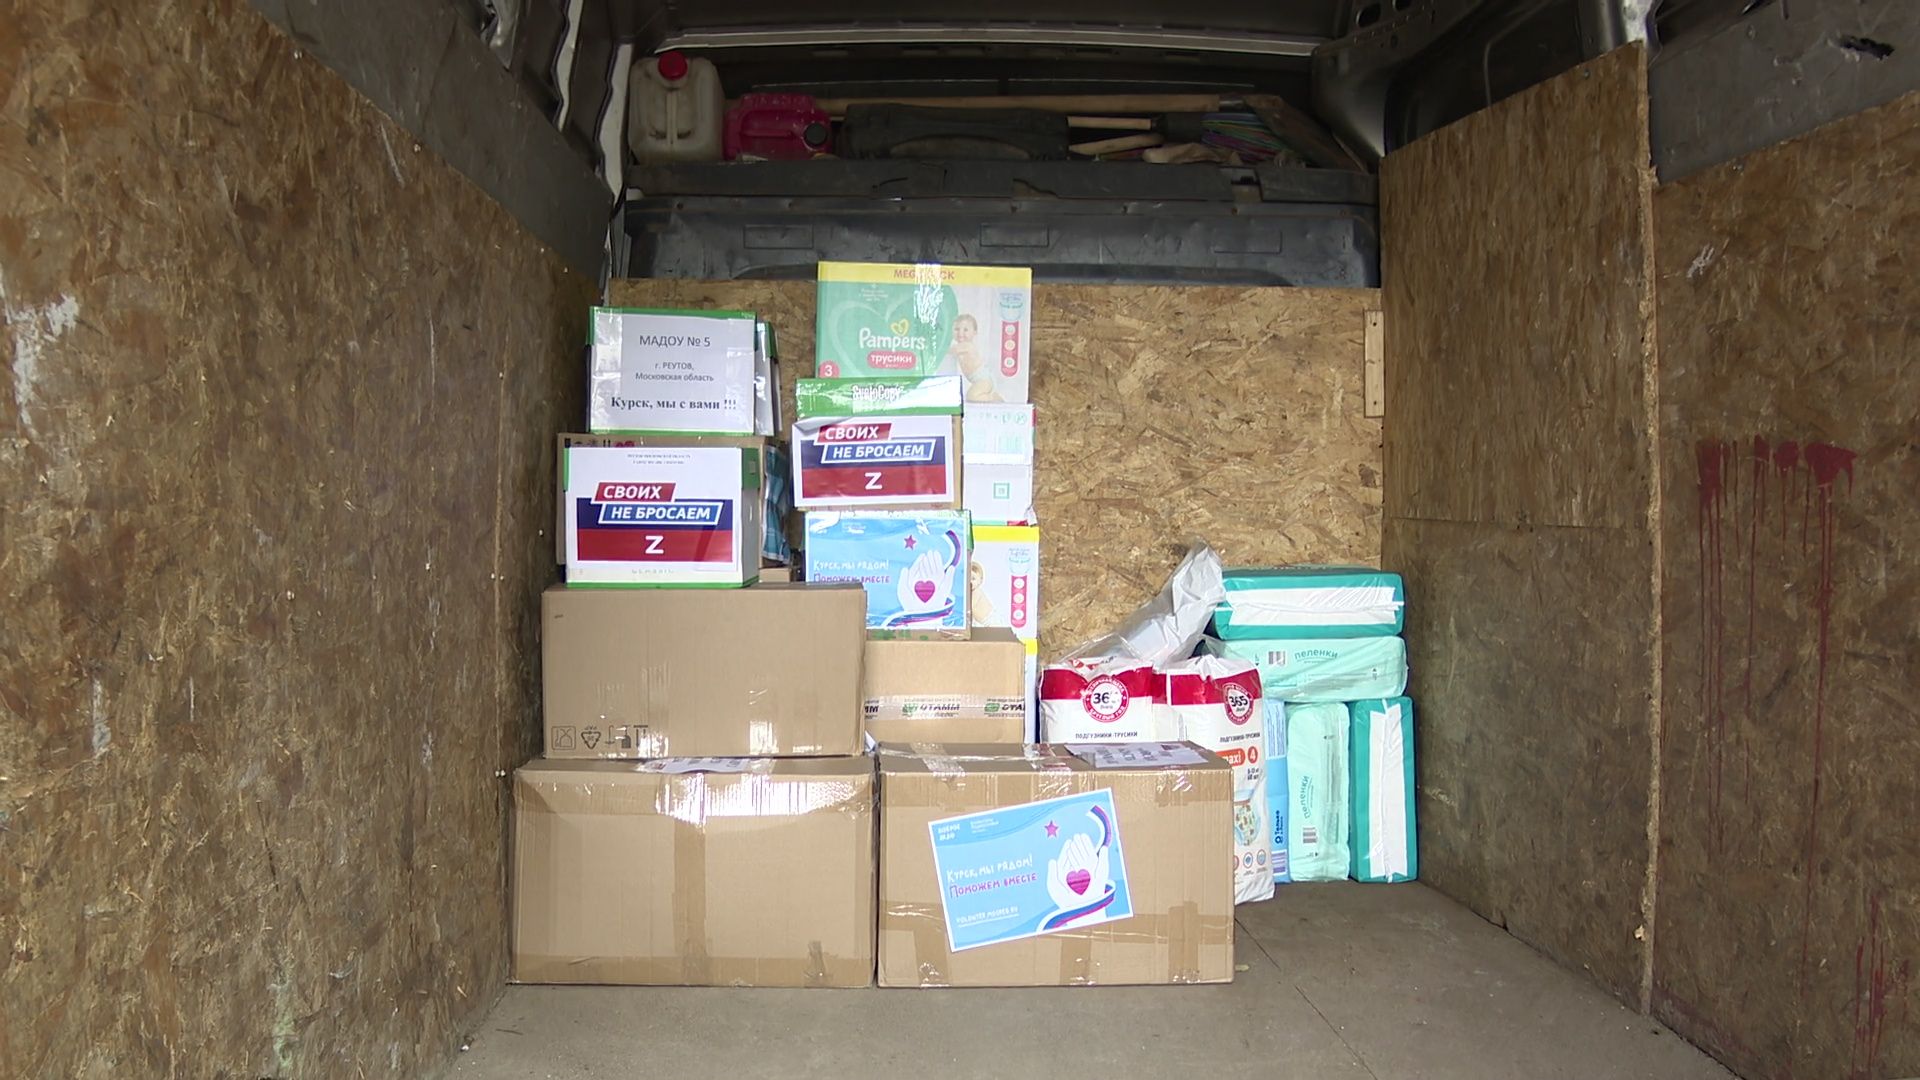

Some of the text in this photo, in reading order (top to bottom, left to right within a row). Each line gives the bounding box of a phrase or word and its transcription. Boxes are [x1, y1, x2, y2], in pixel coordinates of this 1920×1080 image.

[639, 335, 711, 348] МАДОУ № 5
[859, 327, 925, 352] Pampers
[870, 354, 912, 364] трусики
[663, 362, 694, 371] РЕУТОВ,
[824, 365, 833, 377] 3
[635, 372, 714, 382] Московская область
[611, 397, 737, 410] Курск, мы с вами !!!
[824, 426, 879, 441] СВОИХ
[833, 443, 925, 459] НЕ БРОСАЕМ
[865, 472, 883, 490] Z
[603, 485, 662, 499] СВОИХ
[611, 507, 711, 520] НЕ БРОСАЕМ
[645, 535, 664, 554] Z
[1229, 695, 1248, 707] 365
[1249, 749, 1257, 761] 4
